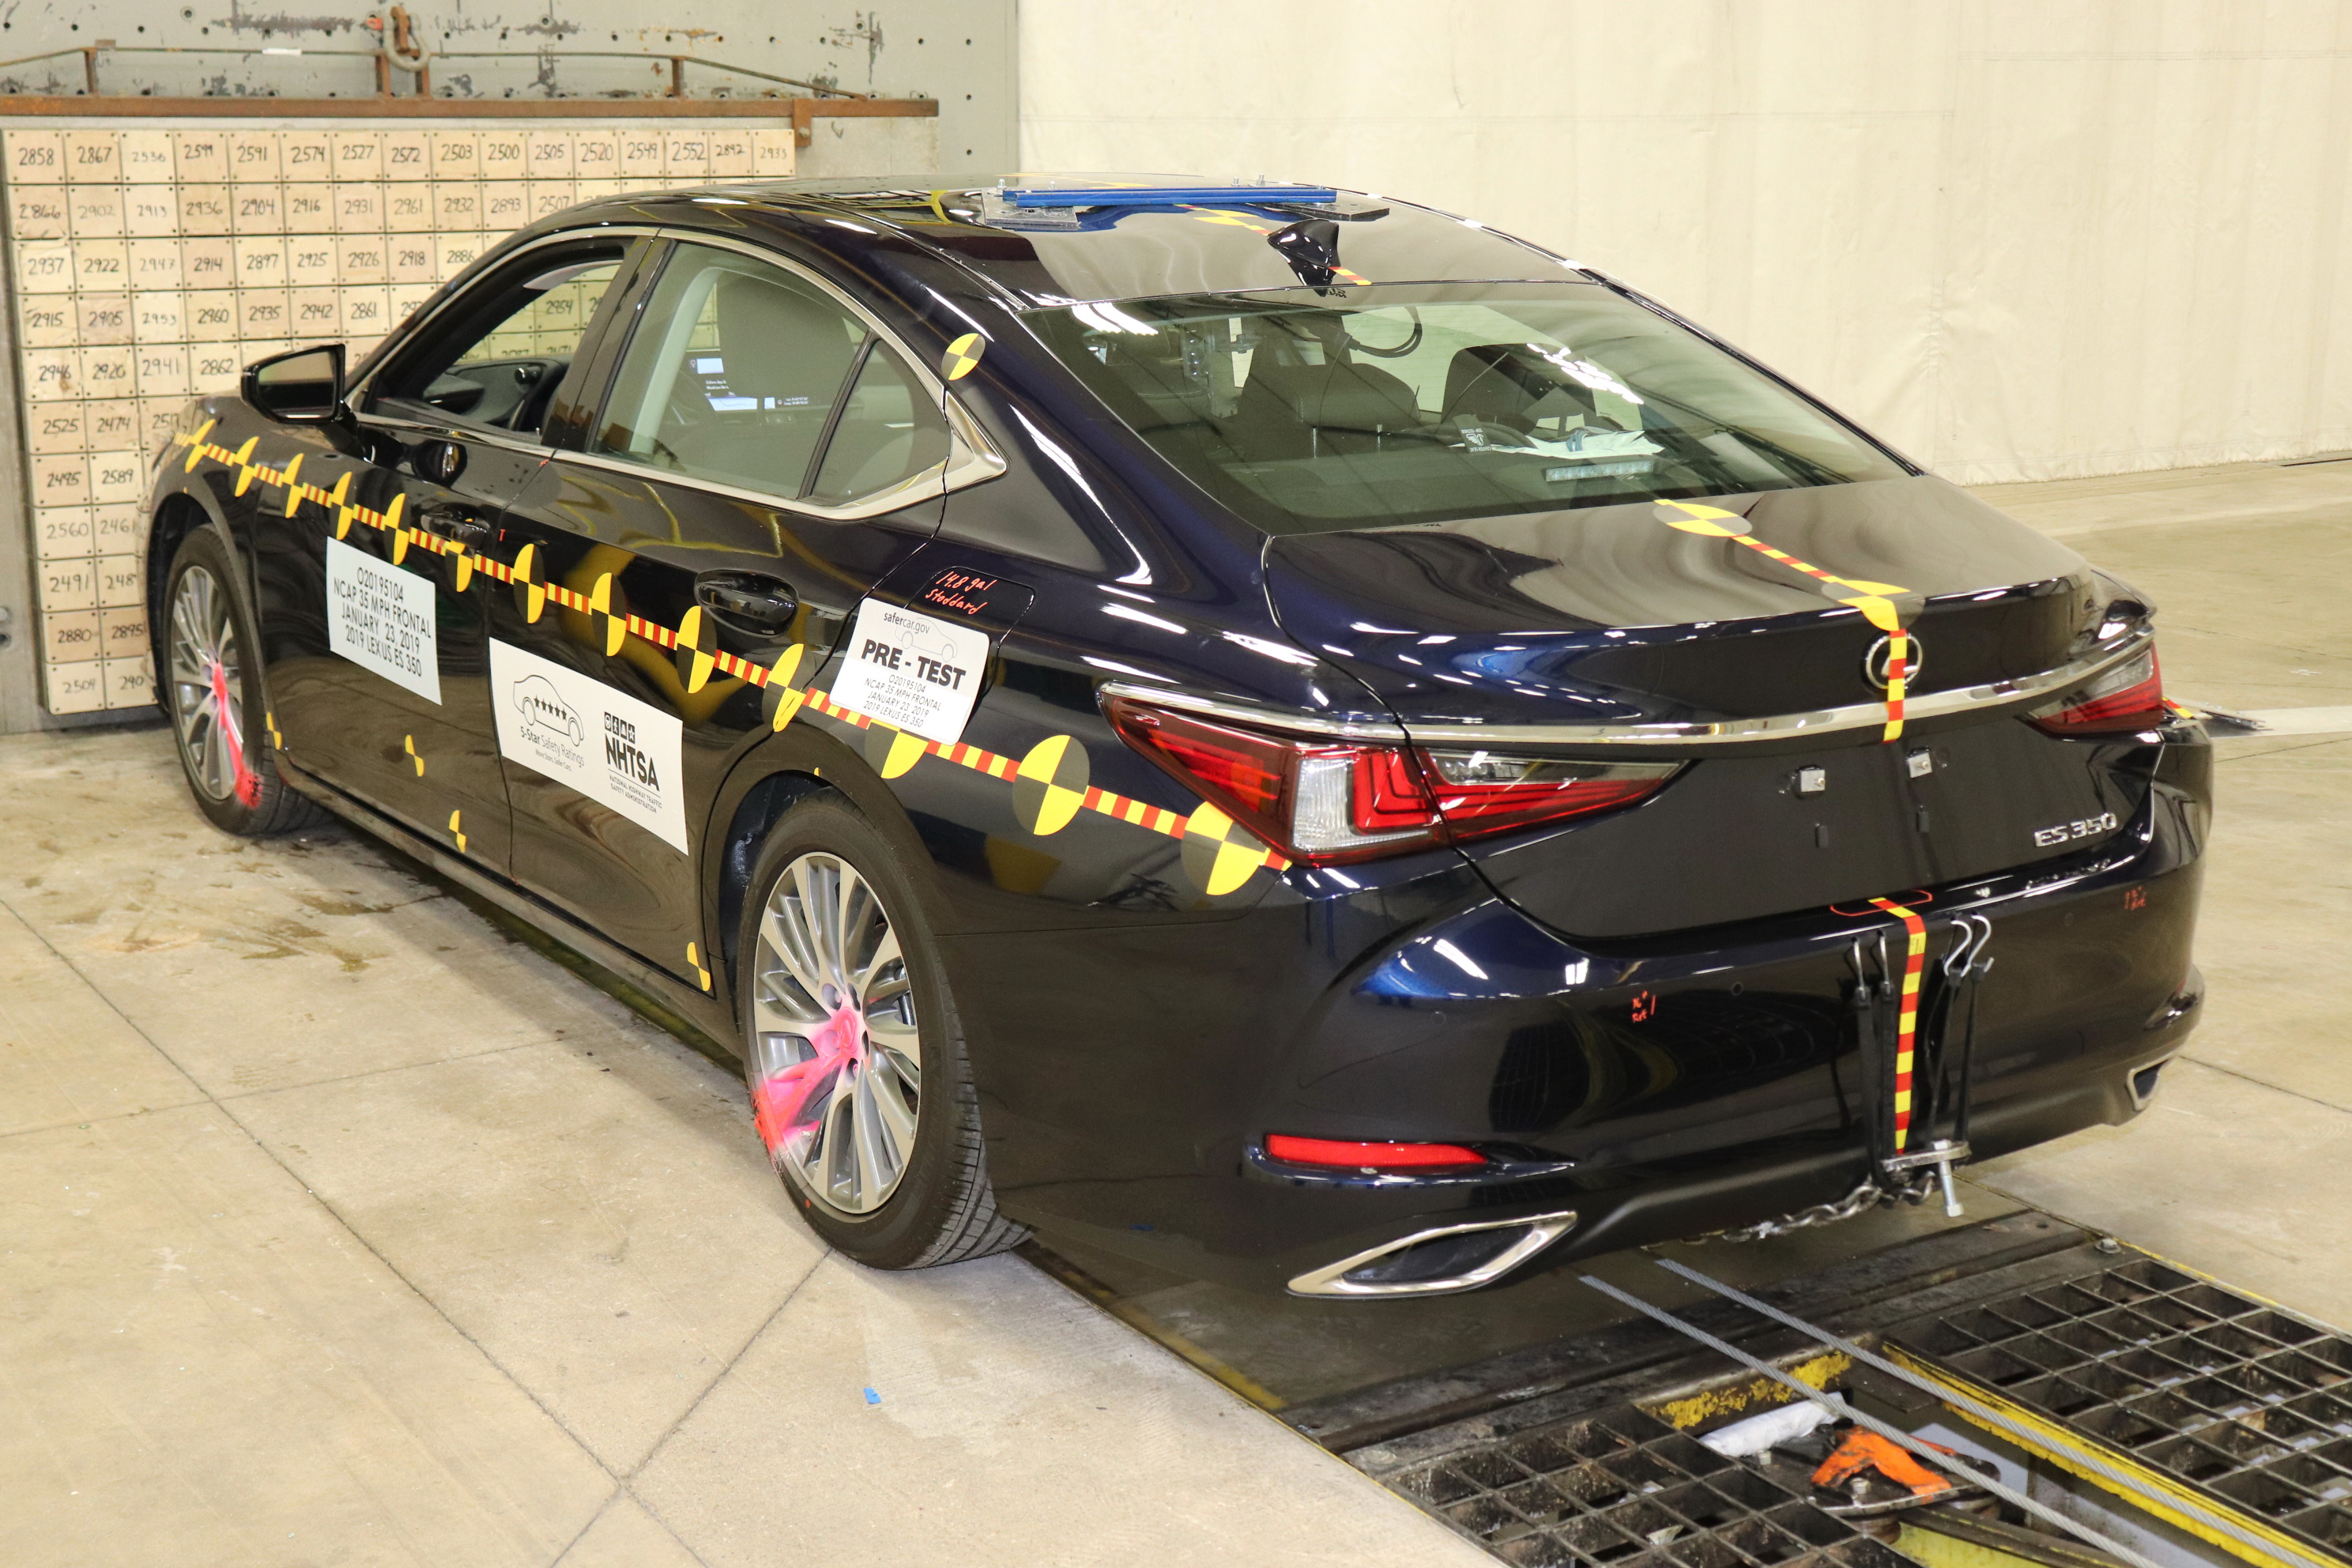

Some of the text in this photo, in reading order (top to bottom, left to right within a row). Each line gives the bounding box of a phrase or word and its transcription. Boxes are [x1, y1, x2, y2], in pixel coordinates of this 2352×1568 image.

[18, 147, 55, 166] 2858
[77, 146, 112, 164] 2867
[237, 145, 267, 162] 2591
[291, 146, 325, 163] 2574
[392, 147, 421, 163] 2572
[441, 144, 473, 161] 2503
[488, 143, 520, 160] 2500
[535, 144, 565, 160] 2505
[580, 142, 614, 162] 2520
[627, 142, 658, 159] 2549
[672, 142, 707, 162] 2552
[715, 144, 745, 157] 2892
[186, 202, 223, 216] 2936
[241, 199, 275, 216] 2904
[292, 198, 320, 213] 2916
[345, 199, 373, 214] 2931
[394, 199, 423, 214] 2961
[444, 198, 474, 213] 2932
[491, 198, 522, 213] 2893
[539, 195, 570, 213] 2507
[139, 258, 175, 270] 2947
[247, 254, 278, 270] 2897
[297, 253, 329, 267] 2925
[348, 251, 379, 267] 2926
[399, 251, 425, 266] 2918
[447, 250, 474, 263] 2886
[28, 258, 65, 275] 2937
[83, 258, 119, 273] 2922
[194, 258, 223, 272] 2914
[198, 309, 229, 324] 2960
[249, 306, 282, 321] 2935
[300, 303, 333, 320] 2942
[351, 301, 377, 319] 2861
[32, 312, 64, 327] 2915
[39, 365, 72, 382] 2946
[142, 358, 179, 375] 2941
[201, 359, 234, 375] 2862
[43, 419, 79, 435] 2525
[97, 417, 130, 432] 2474
[102, 469, 134, 484] 2589
[47, 522, 89, 539] 2560
[50, 574, 89, 592] 2491
[104, 574, 137, 590] 248
[964, 579, 998, 593] gal
[334, 577, 432, 639] NCAP 35 MPH FRONTAL
[341, 603, 420, 655] JANUARY 23, 2019
[884, 611, 931, 635] safercar.gov
[58, 629, 92, 643] 2880
[111, 624, 144, 639] 2895
[345, 624, 422, 678] 2019 LEXUS ES 350
[861, 639, 903, 671] PRE
[918, 655, 967, 691] TEST
[119, 676, 144, 690] 290
[865, 677, 942, 711] NCAP 35 MPH FRONTAL
[867, 691, 899, 707] JANUARY
[911, 707, 929, 718] 2019
[863, 700, 924, 728] 2019 LEXUS ES 350
[520, 726, 585, 768] 5-Star Safety Ratings
[605, 733, 661, 792] NHTSA
[609, 774, 628, 790] NATIONAL
[646, 795, 663, 809] TRAFFIC
[610, 782, 624, 796] SAFETY
[2034, 812, 2118, 847] ES 350
